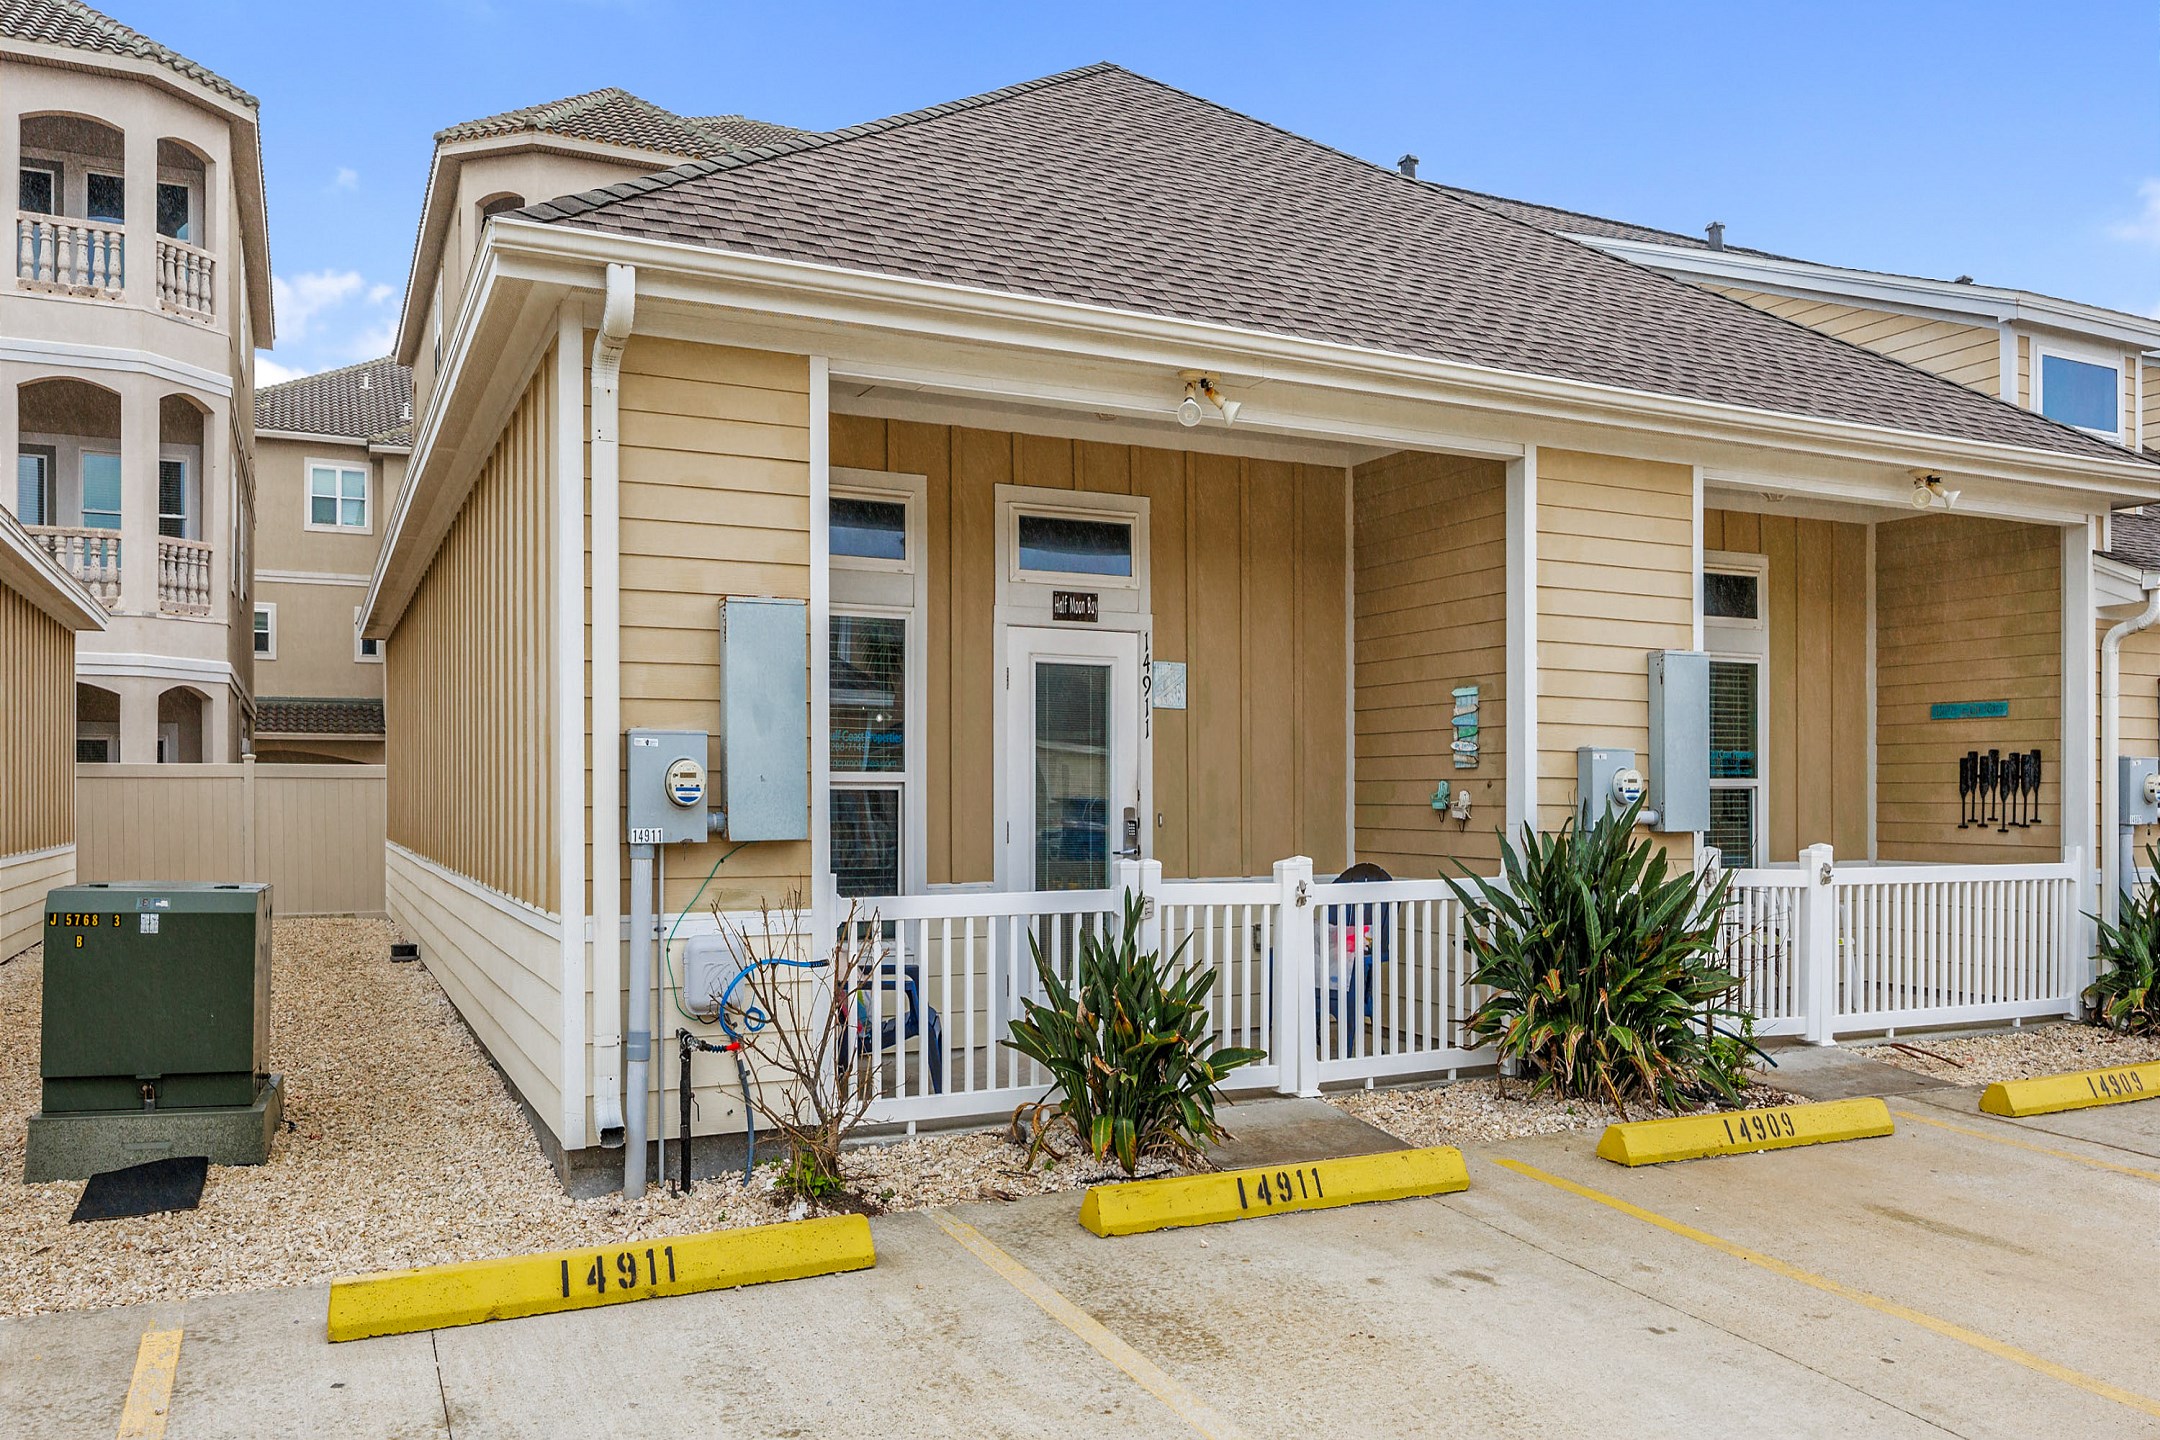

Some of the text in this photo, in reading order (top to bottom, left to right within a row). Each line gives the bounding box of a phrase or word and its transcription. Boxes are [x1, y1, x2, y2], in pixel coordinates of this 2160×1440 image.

[1054, 595, 1098, 619] Half Moon Bay
[1142, 631, 1152, 739] 14911
[831, 729, 841, 741] ulf
[842, 729, 864, 742] Coast
[632, 829, 662, 843] 14911
[50, 914, 121, 927] J 5768 3
[76, 936, 83, 948] B
[2086, 1071, 2143, 1098] 14909
[1723, 1112, 1795, 1144] 14909
[1237, 1168, 1323, 1209] 14911
[561, 1246, 676, 1297] 14911
